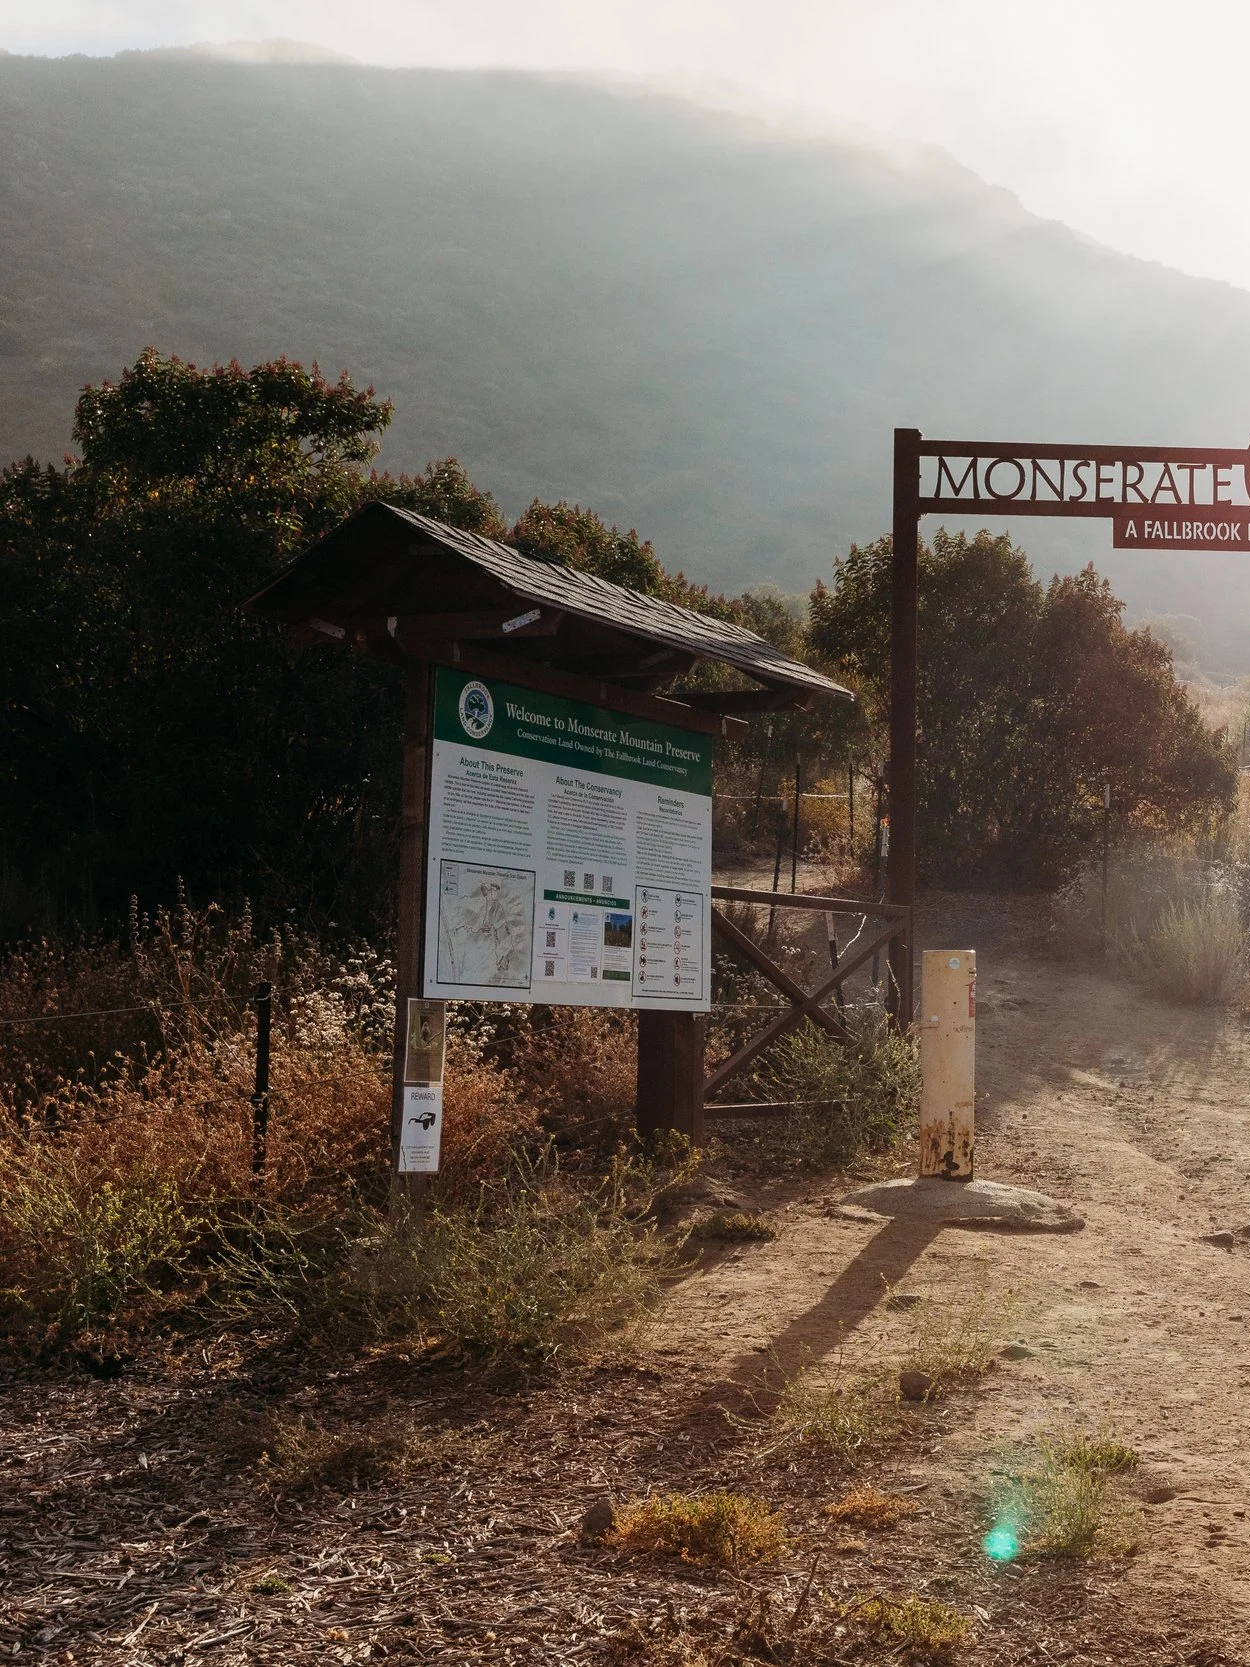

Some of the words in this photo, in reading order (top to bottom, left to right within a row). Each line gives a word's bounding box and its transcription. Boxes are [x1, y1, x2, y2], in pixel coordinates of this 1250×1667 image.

[934, 456, 1233, 506] MONSERATE
[1126, 520, 1138, 538] A
[1144, 520, 1241, 541] FALLBROOK
[506, 702, 551, 727] Welcome
[554, 715, 565, 730] to
[568, 717, 617, 743] Monserate
[620, 729, 663, 753] Mountain
[666, 742, 701, 762] Preserve
[517, 729, 557, 745] Conservation
[558, 737, 574, 750] Land
[575, 741, 595, 755] Owned
[604, 748, 615, 759] The
[616, 750, 642, 765] Fallbrook
[643, 755, 656, 768] Land
[657, 758, 688, 776] Conservancy
[460, 756, 480, 768] About
[481, 761, 495, 772] This
[496, 763, 524, 777] Preserve
[556, 776, 574, 788] About
[575, 780, 586, 790] The
[587, 782, 622, 798] Conservancy
[658, 795, 684, 808] Reminders
[411, 1092, 436, 1101] REWARD
